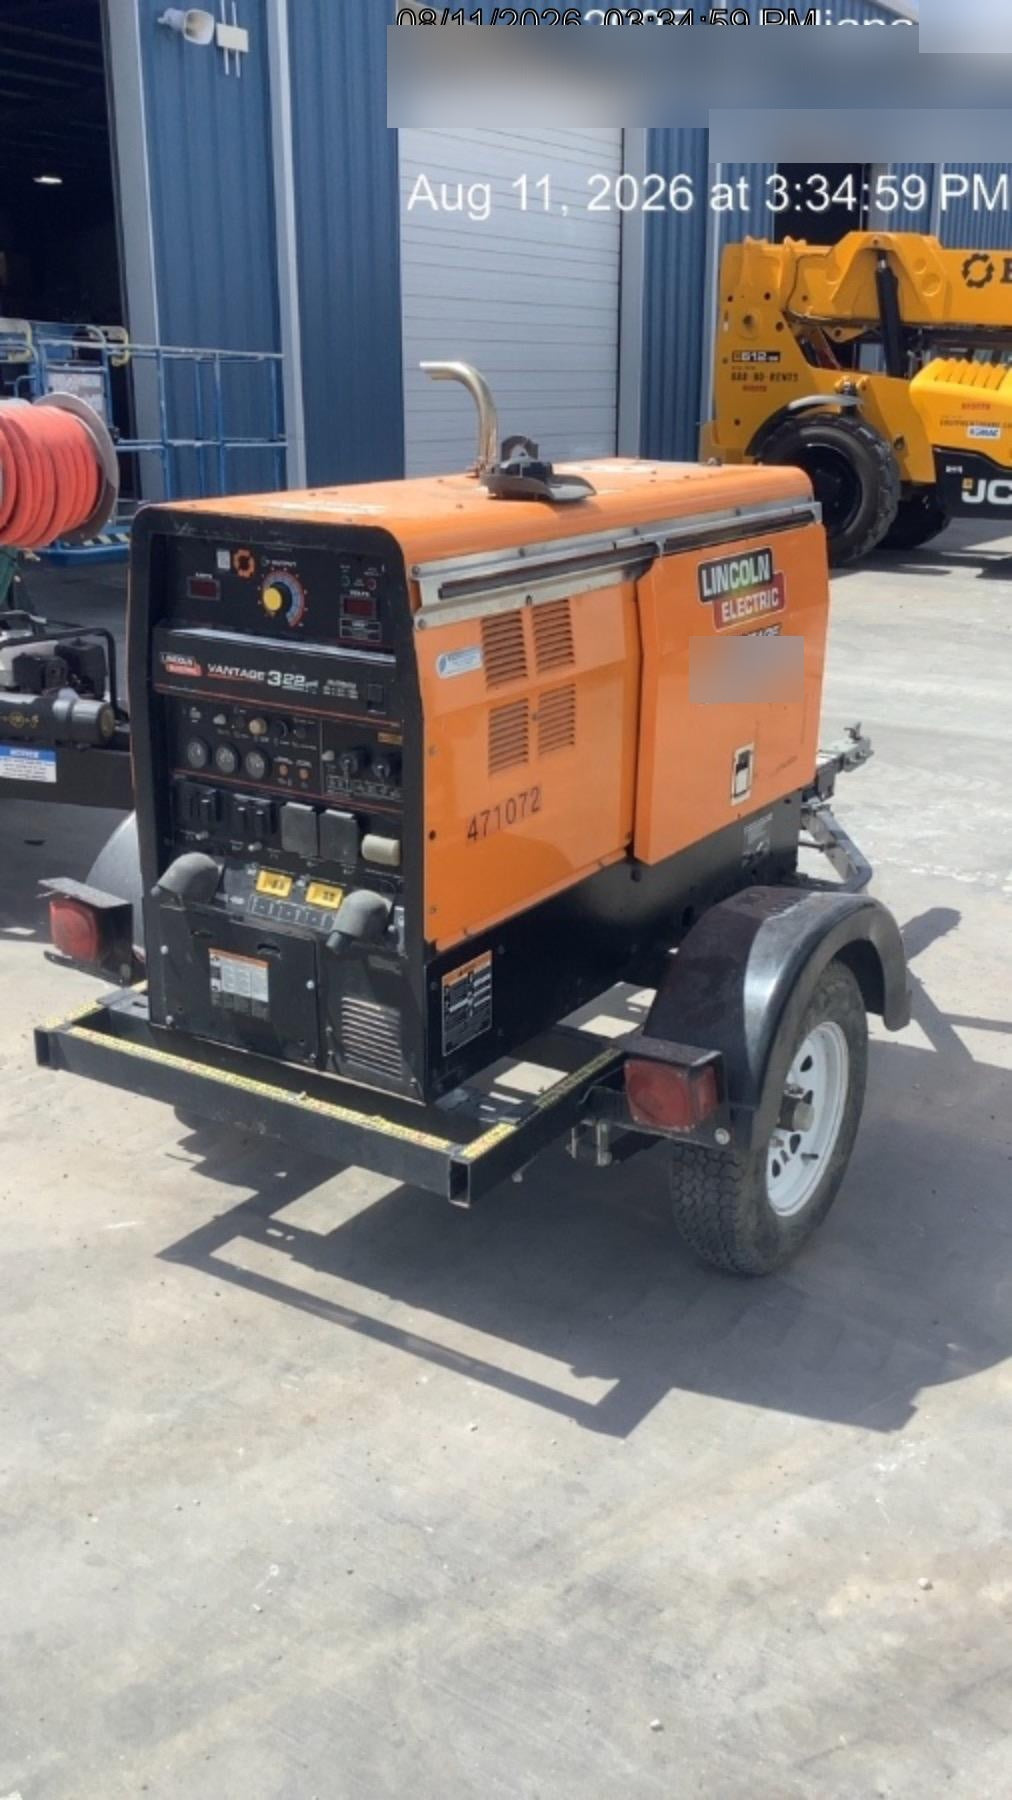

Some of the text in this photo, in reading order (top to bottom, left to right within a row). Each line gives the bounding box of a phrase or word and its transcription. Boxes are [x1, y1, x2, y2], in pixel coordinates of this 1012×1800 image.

[701, 553, 771, 597] LINCOLN
[721, 586, 780, 624] ELECTRIC
[207, 663, 264, 681] VANTAGE
[267, 669, 307, 688] 322
[466, 785, 542, 842] 471072
